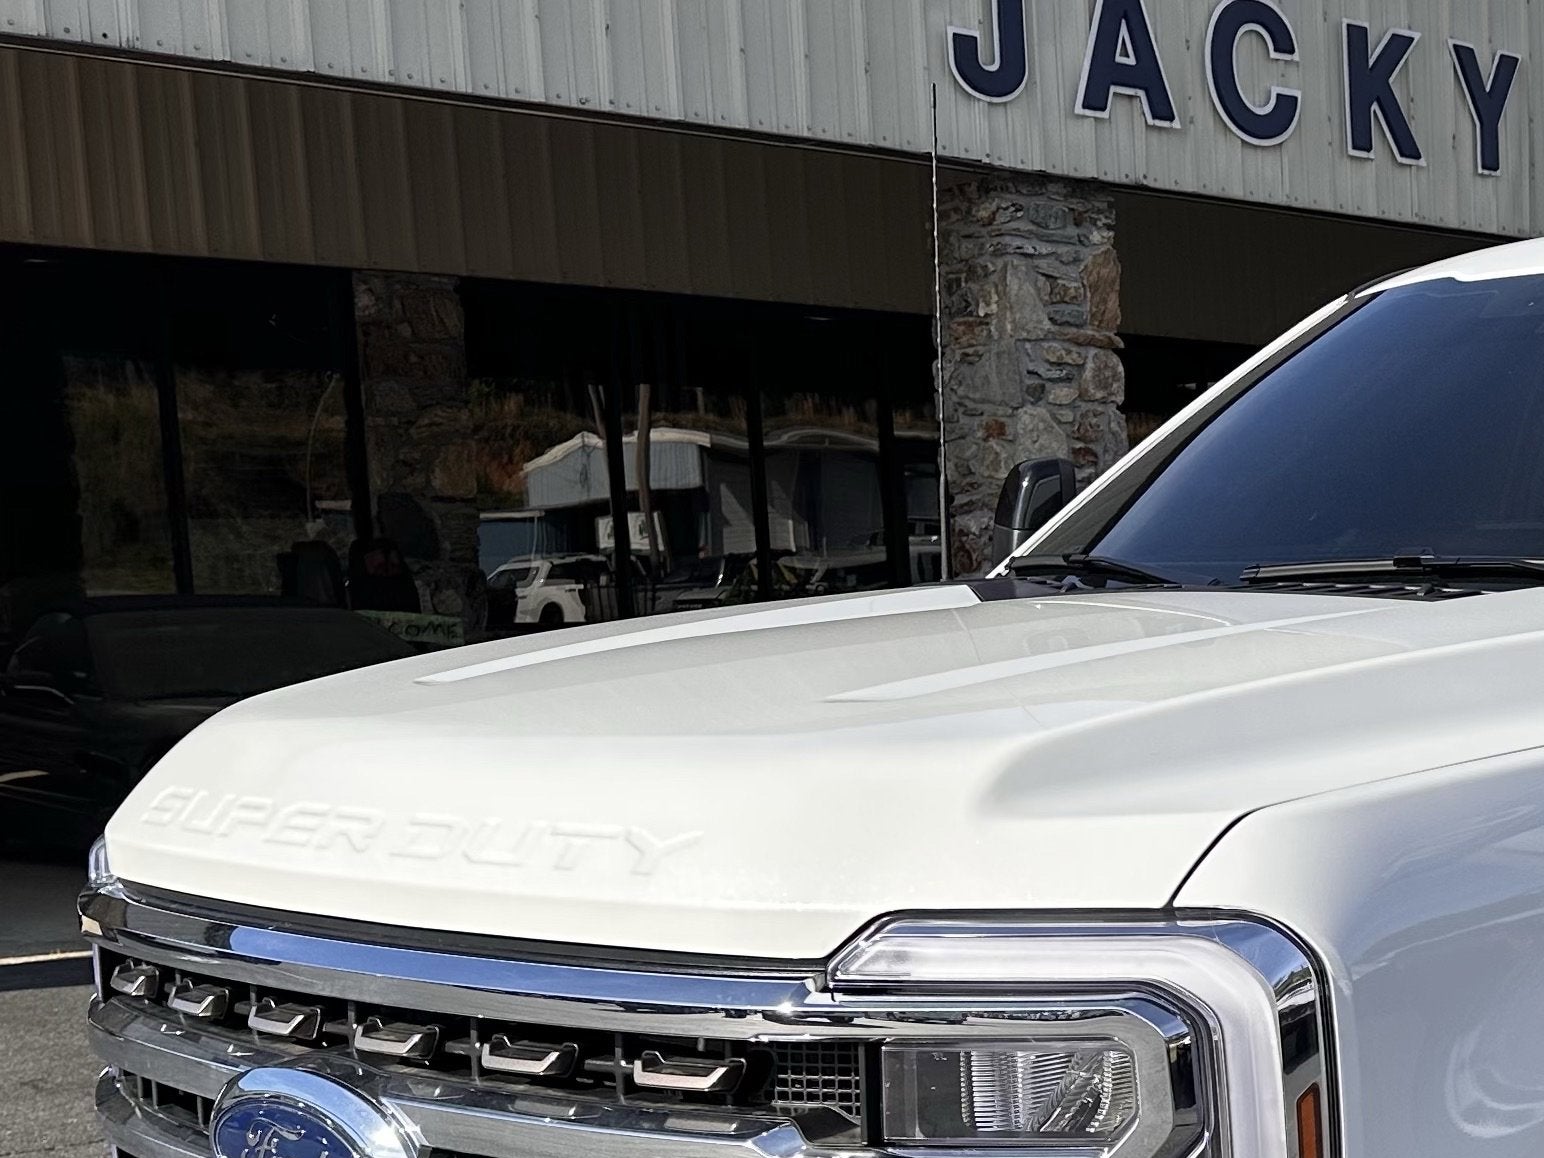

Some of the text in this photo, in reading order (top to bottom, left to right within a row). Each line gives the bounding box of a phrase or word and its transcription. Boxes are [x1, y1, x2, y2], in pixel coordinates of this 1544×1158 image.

[947, 0, 1522, 176] JACKY
[140, 785, 705, 876] SUPER DUTY
